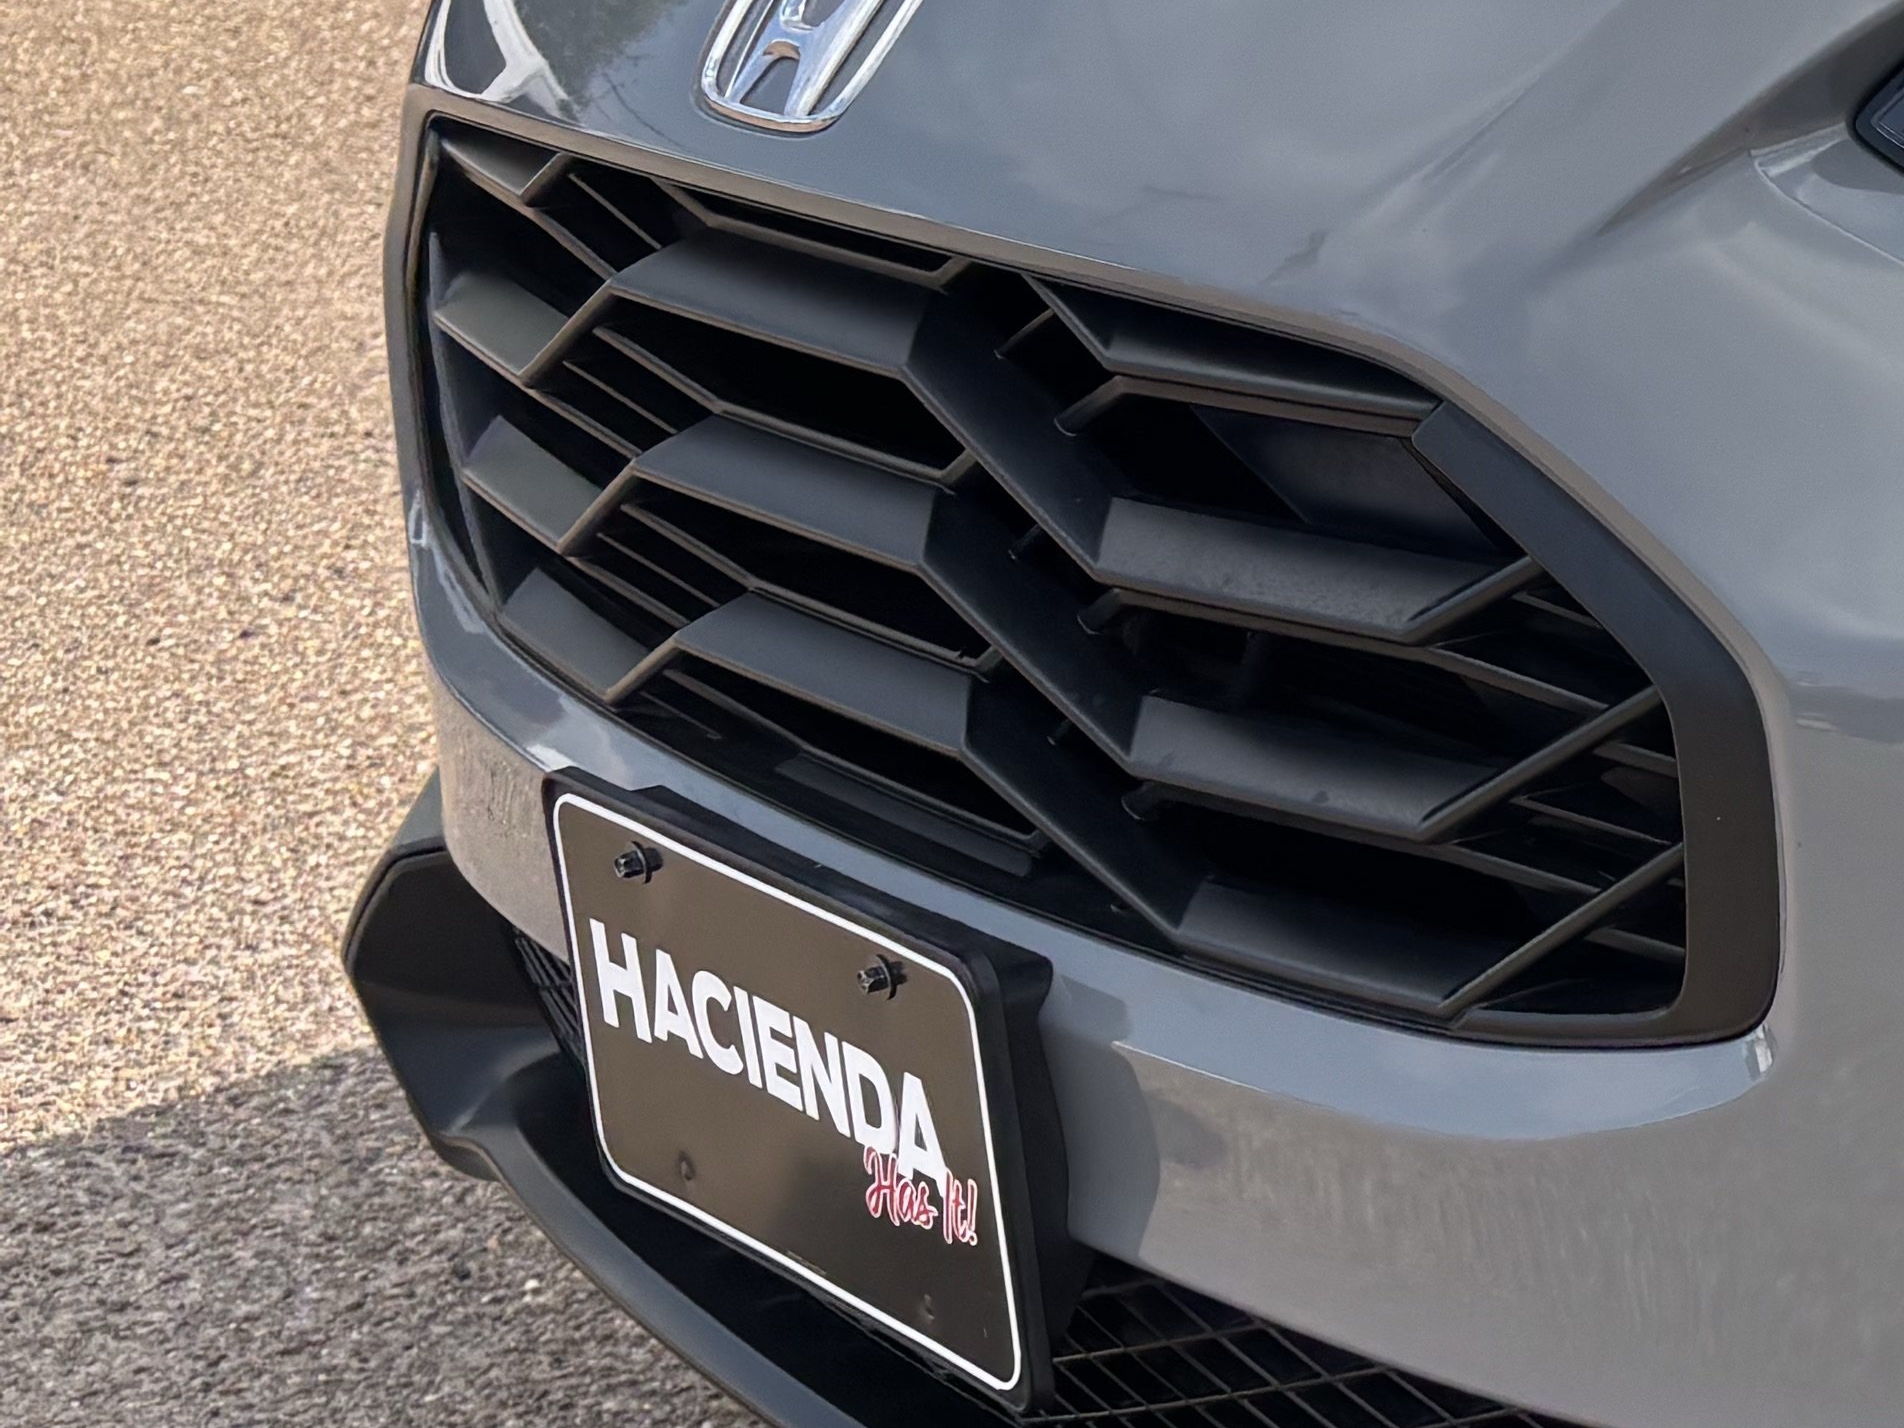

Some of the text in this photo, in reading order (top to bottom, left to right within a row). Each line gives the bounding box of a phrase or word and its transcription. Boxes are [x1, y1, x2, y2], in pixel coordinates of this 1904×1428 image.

[589, 918, 947, 1199] HACIENDA
[863, 1145, 978, 1246] Has It!
